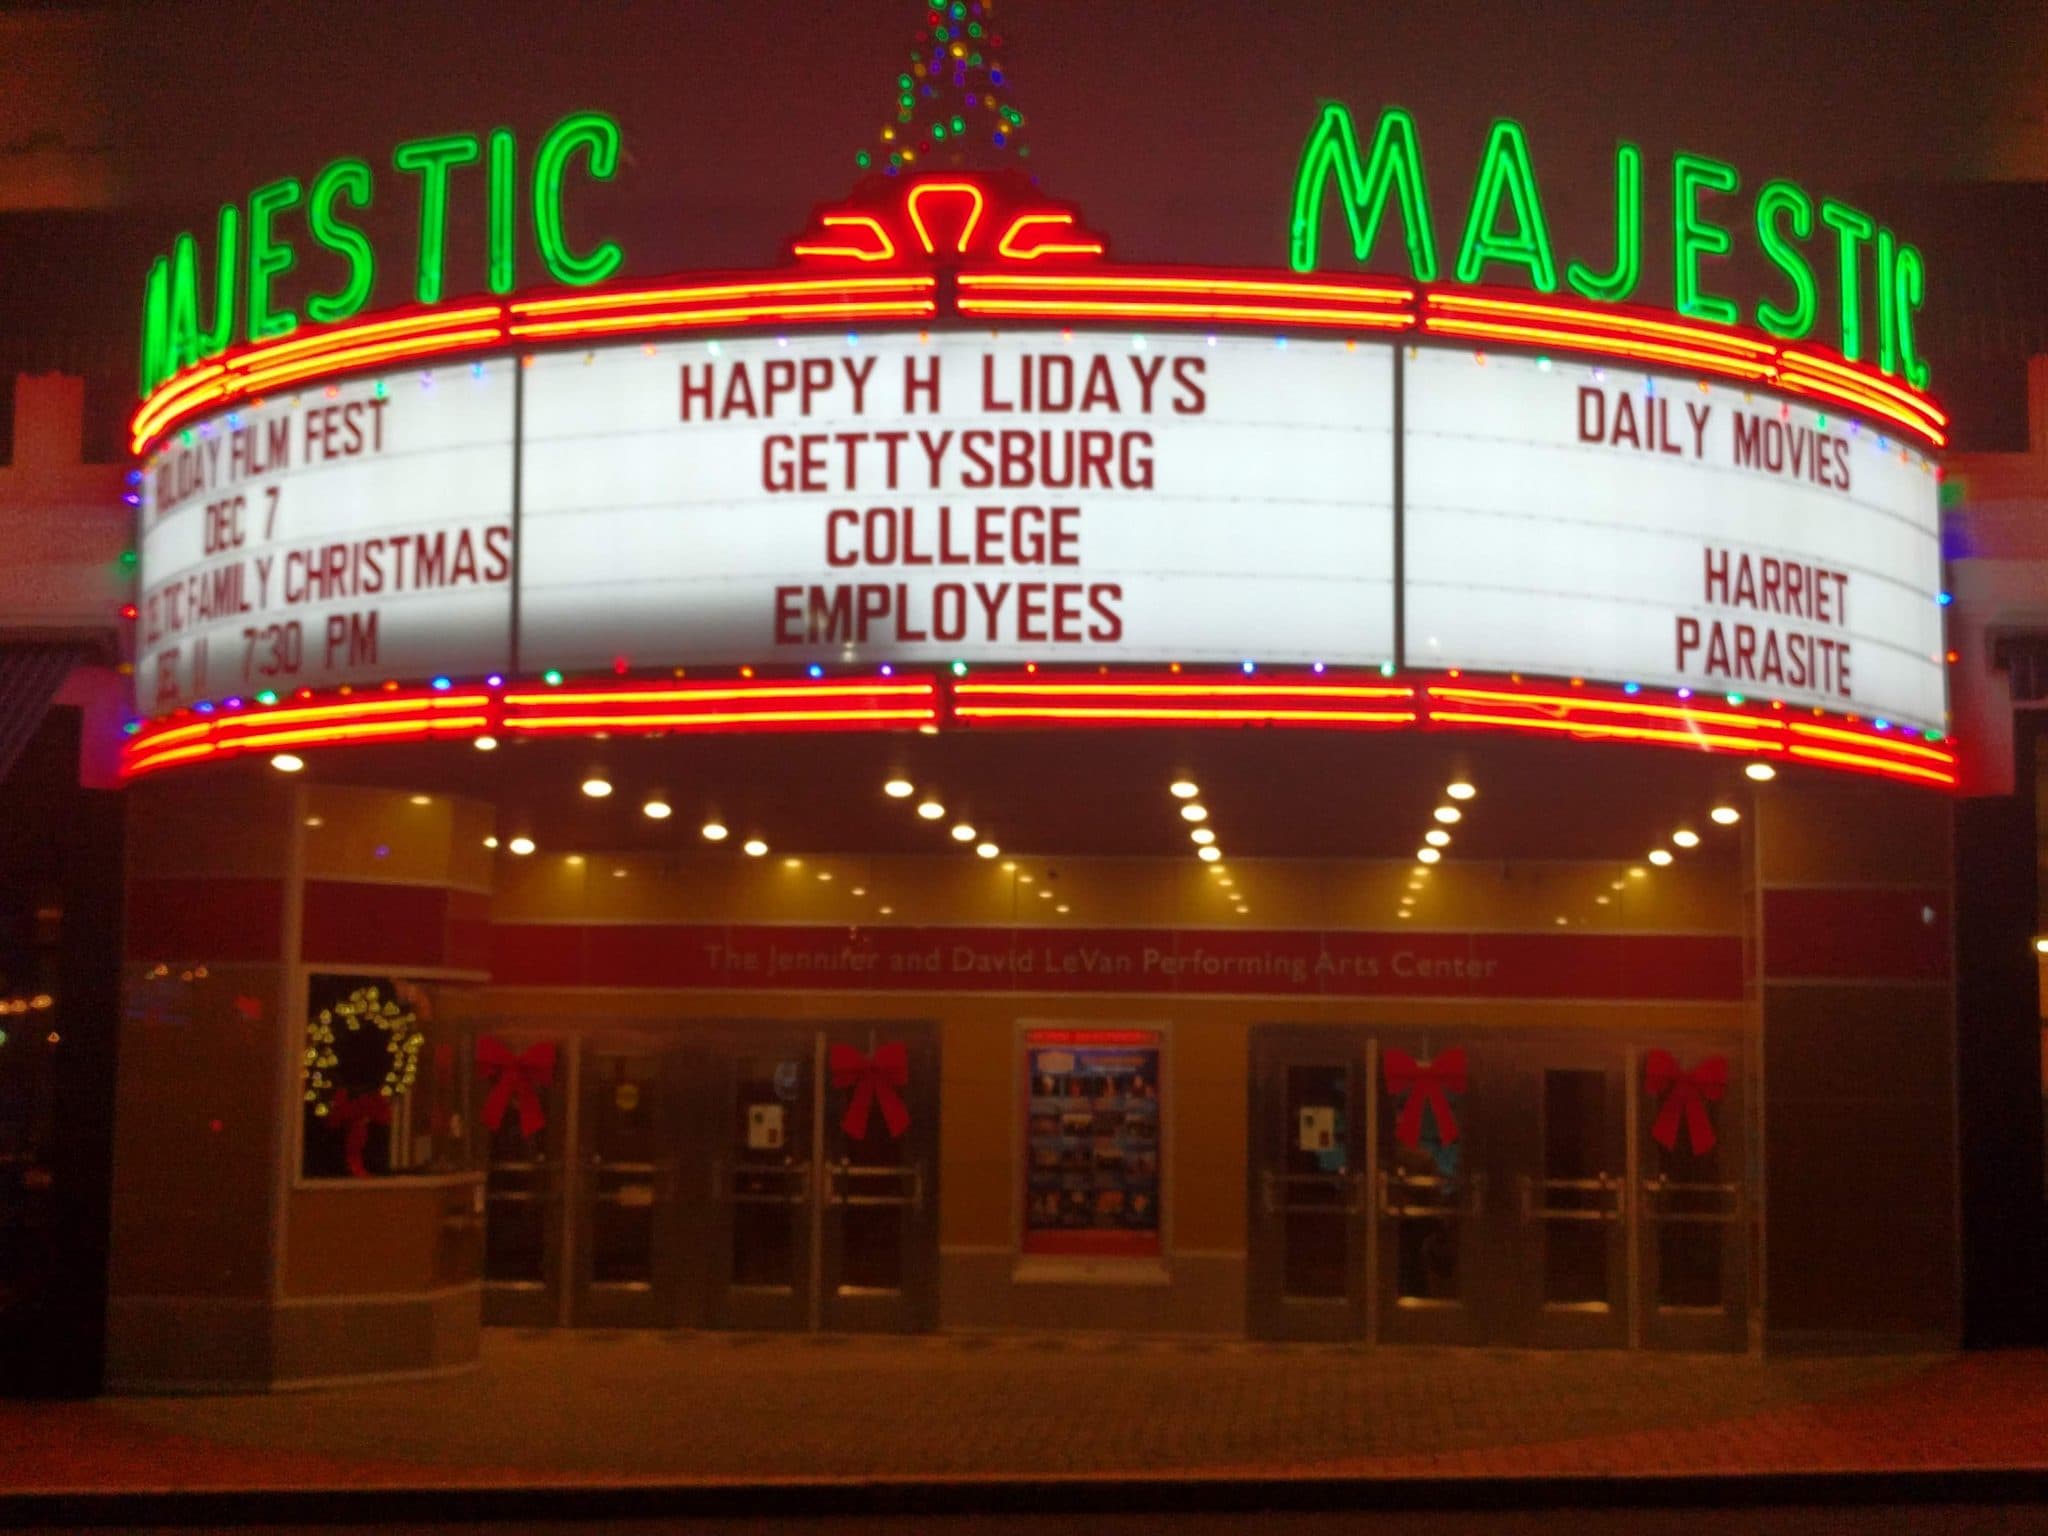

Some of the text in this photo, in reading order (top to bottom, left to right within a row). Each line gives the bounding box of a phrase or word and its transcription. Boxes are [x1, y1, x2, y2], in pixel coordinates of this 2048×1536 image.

[1290, 102, 1929, 391] MAJESTIC
[679, 356, 877, 421] HAPPY
[231, 414, 290, 482] FILM
[305, 398, 388, 464] FEST
[762, 430, 1154, 493] GETTYSBURG
[1577, 385, 1851, 492] DAILY MOVIES
[205, 486, 280, 556] DEC 7
[826, 506, 1080, 568] COLLEGE
[187, 554, 273, 628] FAMILY
[285, 526, 512, 604] CHRISTMAS
[1704, 547, 1848, 627] HARRIET
[325, 610, 379, 670] PM
[774, 583, 1123, 646] EMPLOYEES
[1675, 616, 1851, 698] PARASITE
[704, 944, 1498, 984] The Jennifer and David LeVan Performing Arts Center
